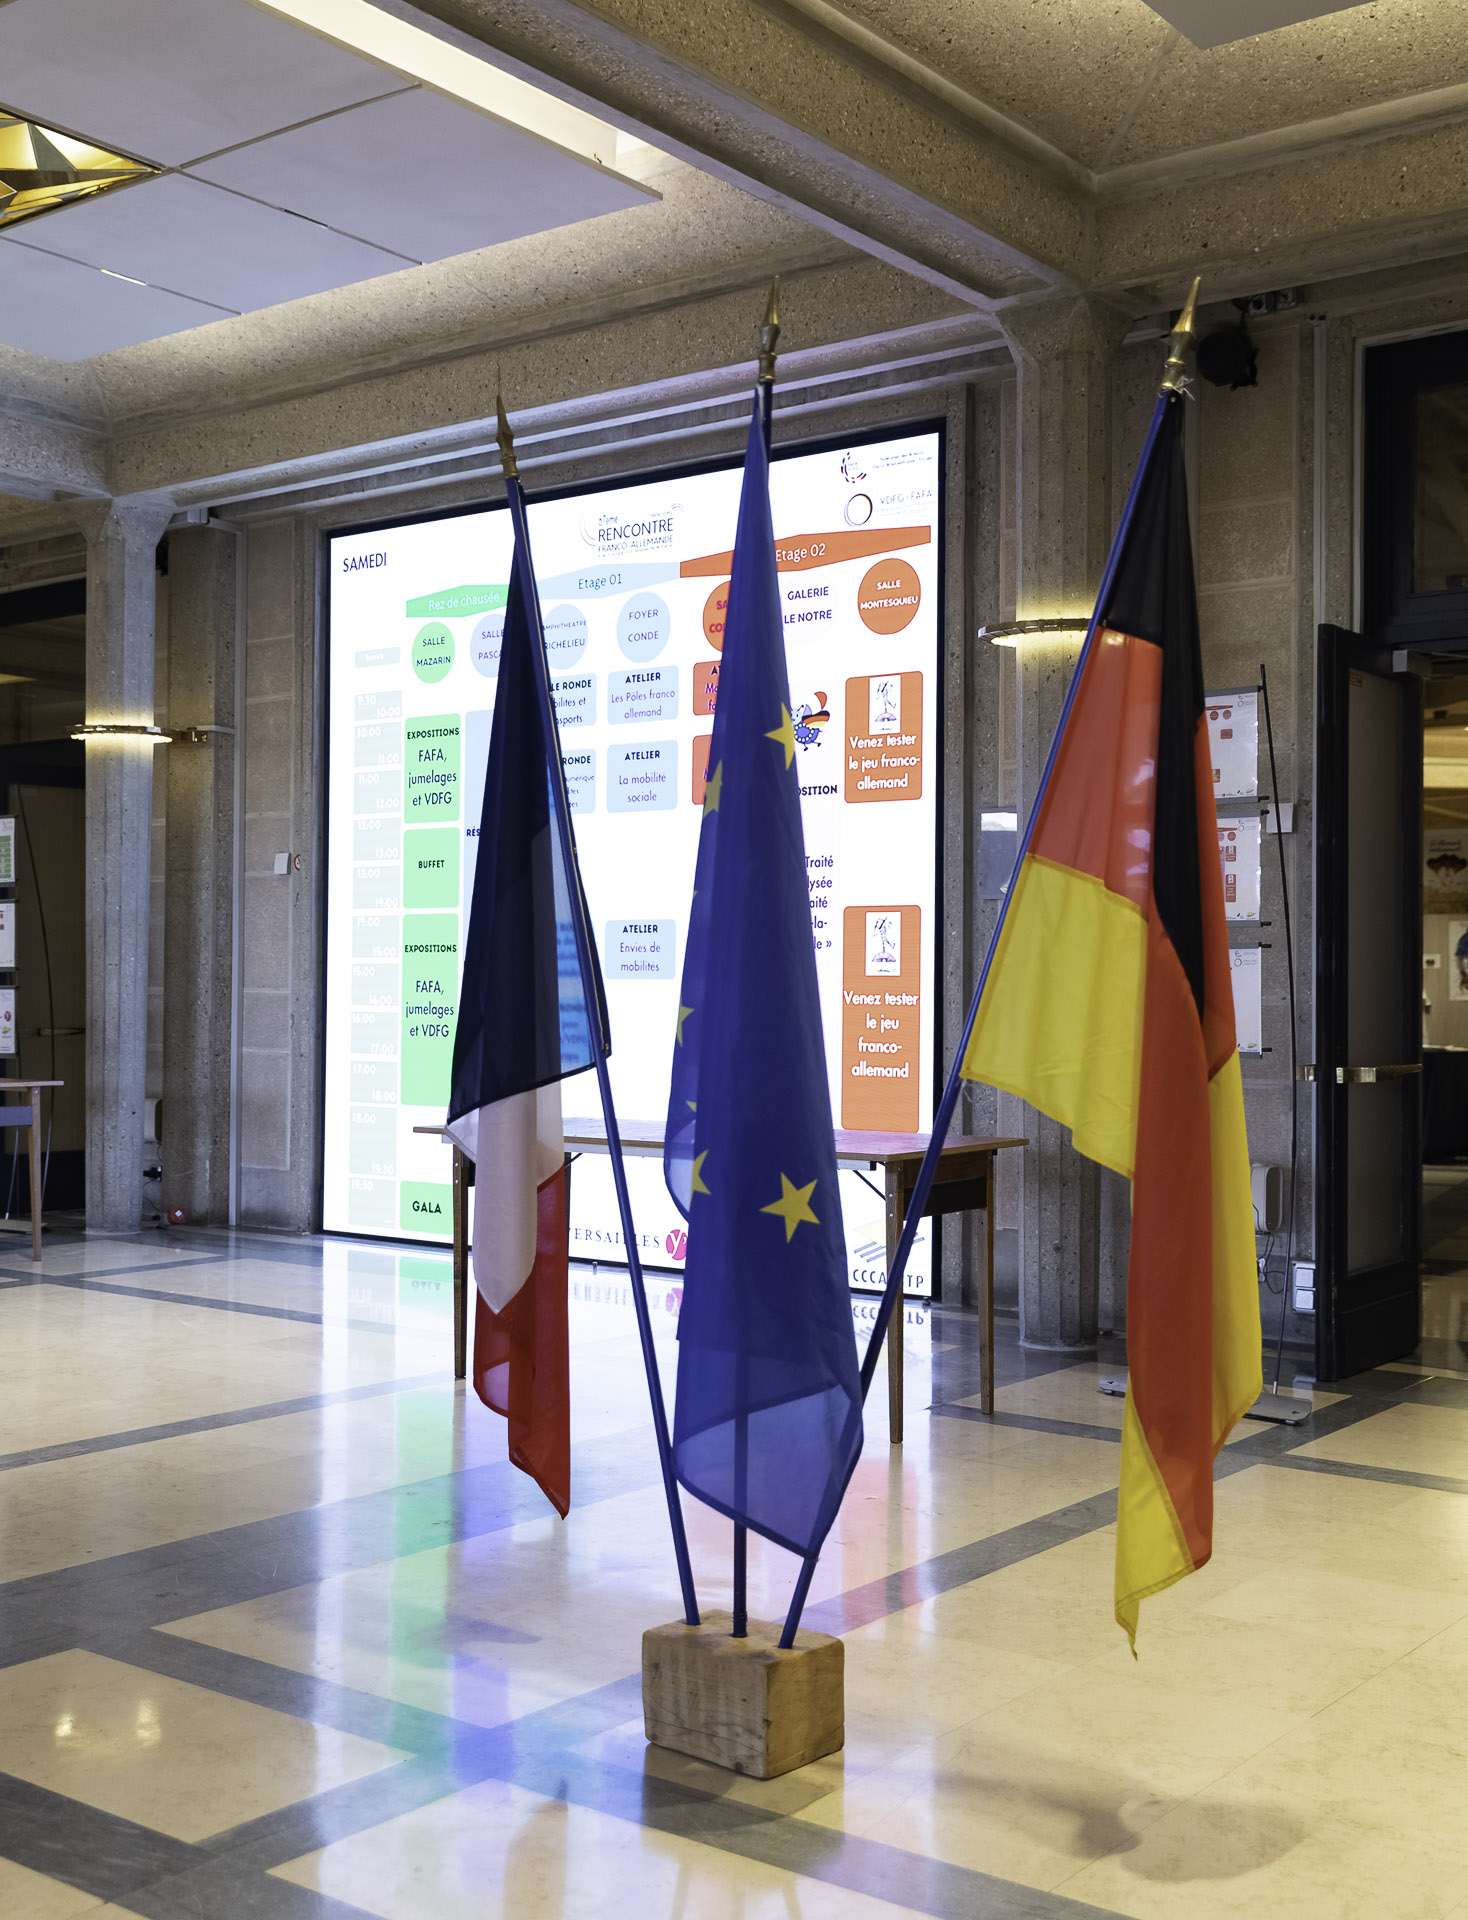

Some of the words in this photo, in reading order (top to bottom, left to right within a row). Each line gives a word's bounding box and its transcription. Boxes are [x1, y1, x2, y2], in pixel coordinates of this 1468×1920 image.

[598, 517, 673, 542] RENCONTRE
[775, 549, 808, 563] Etage
[810, 543, 826, 557] 02
[343, 551, 387, 573] SAMEDI
[578, 579, 607, 590] Etage
[609, 573, 622, 585] 01
[876, 579, 902, 591] SALLE
[787, 586, 830, 601] GALERIE
[860, 595, 919, 610] MONTESQUIEU
[628, 608, 659, 621] FOYER
[784, 614, 796, 624] LE
[797, 609, 833, 623] NOTRE
[422, 636, 446, 647] SALLE
[627, 630, 660, 643] CONDE
[416, 656, 452, 667] MAZARIN
[478, 649, 501, 661] PASC
[562, 679, 592, 691] RONDE
[625, 672, 662, 684] ATELIER
[611, 693, 624, 704] Les
[624, 705, 662, 719] allemand
[407, 727, 460, 740] EXPOSITIONS
[849, 736, 884, 750] Venez
[886, 733, 918, 748] tester
[418, 748, 447, 763] FAFA,
[624, 750, 661, 762] ATELIER
[848, 756, 859, 770] le
[861, 757, 878, 772] jeu
[881, 753, 921, 769] franco-
[408, 769, 457, 789] jumelages
[619, 775, 629, 785] La
[856, 773, 909, 791] allemand
[412, 797, 422, 807] et
[424, 791, 453, 805] VDFG
[627, 789, 657, 803] sociale
[418, 859, 445, 869] BUFFET
[807, 875, 833, 892] lysée
[809, 895, 828, 908] aité
[622, 924, 659, 934] ATELIER
[404, 944, 457, 953] EXPOSITIONS
[620, 942, 647, 953] Envies
[649, 940, 661, 953] de
[415, 980, 445, 995] FAFA,
[844, 991, 881, 1005] Venez
[885, 991, 919, 1006] tester
[405, 1000, 455, 1019] jumelages
[865, 1012, 877, 1029] le
[880, 1013, 899, 1033] jeu
[409, 1025, 419, 1037] et
[422, 1024, 450, 1038] VDFG
[858, 1036, 902, 1054] franco-
[851, 1060, 909, 1078] allemand
[412, 1200, 442, 1215] GALA
